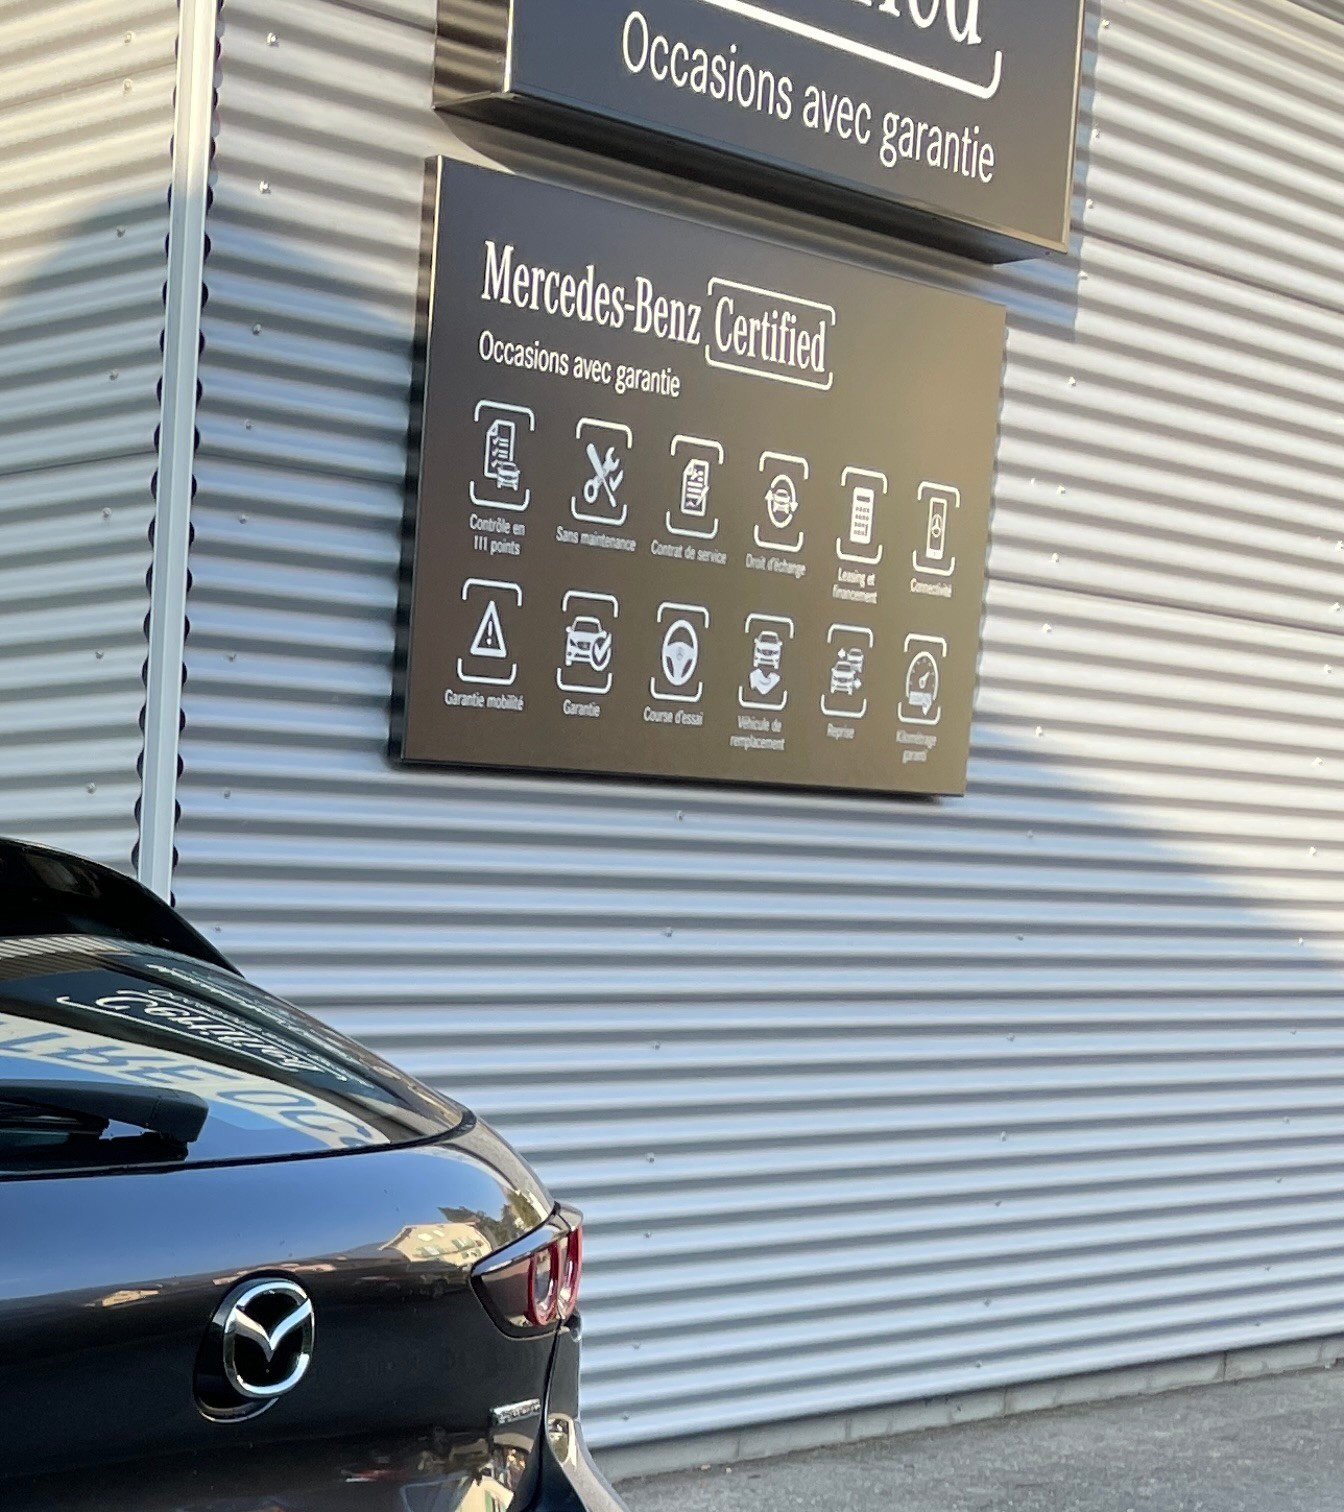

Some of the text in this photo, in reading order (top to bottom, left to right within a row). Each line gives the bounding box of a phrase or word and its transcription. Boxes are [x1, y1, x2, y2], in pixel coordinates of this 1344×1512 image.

[622, 10, 794, 121] Occasions
[802, 85, 872, 145] avec
[879, 111, 996, 184] garantie
[480, 239, 828, 373] Mercedes-Benz Certified
[478, 330, 681, 398] Occasions avec garantie
[469, 513, 526, 536] Contrôle en
[490, 538, 521, 556] points
[555, 525, 637, 552] Sans maintenance
[650, 539, 727, 565] Contrat de service
[444, 688, 524, 711] Garantie mobilité
[563, 698, 601, 717] Garantie
[643, 706, 673, 724] Course
